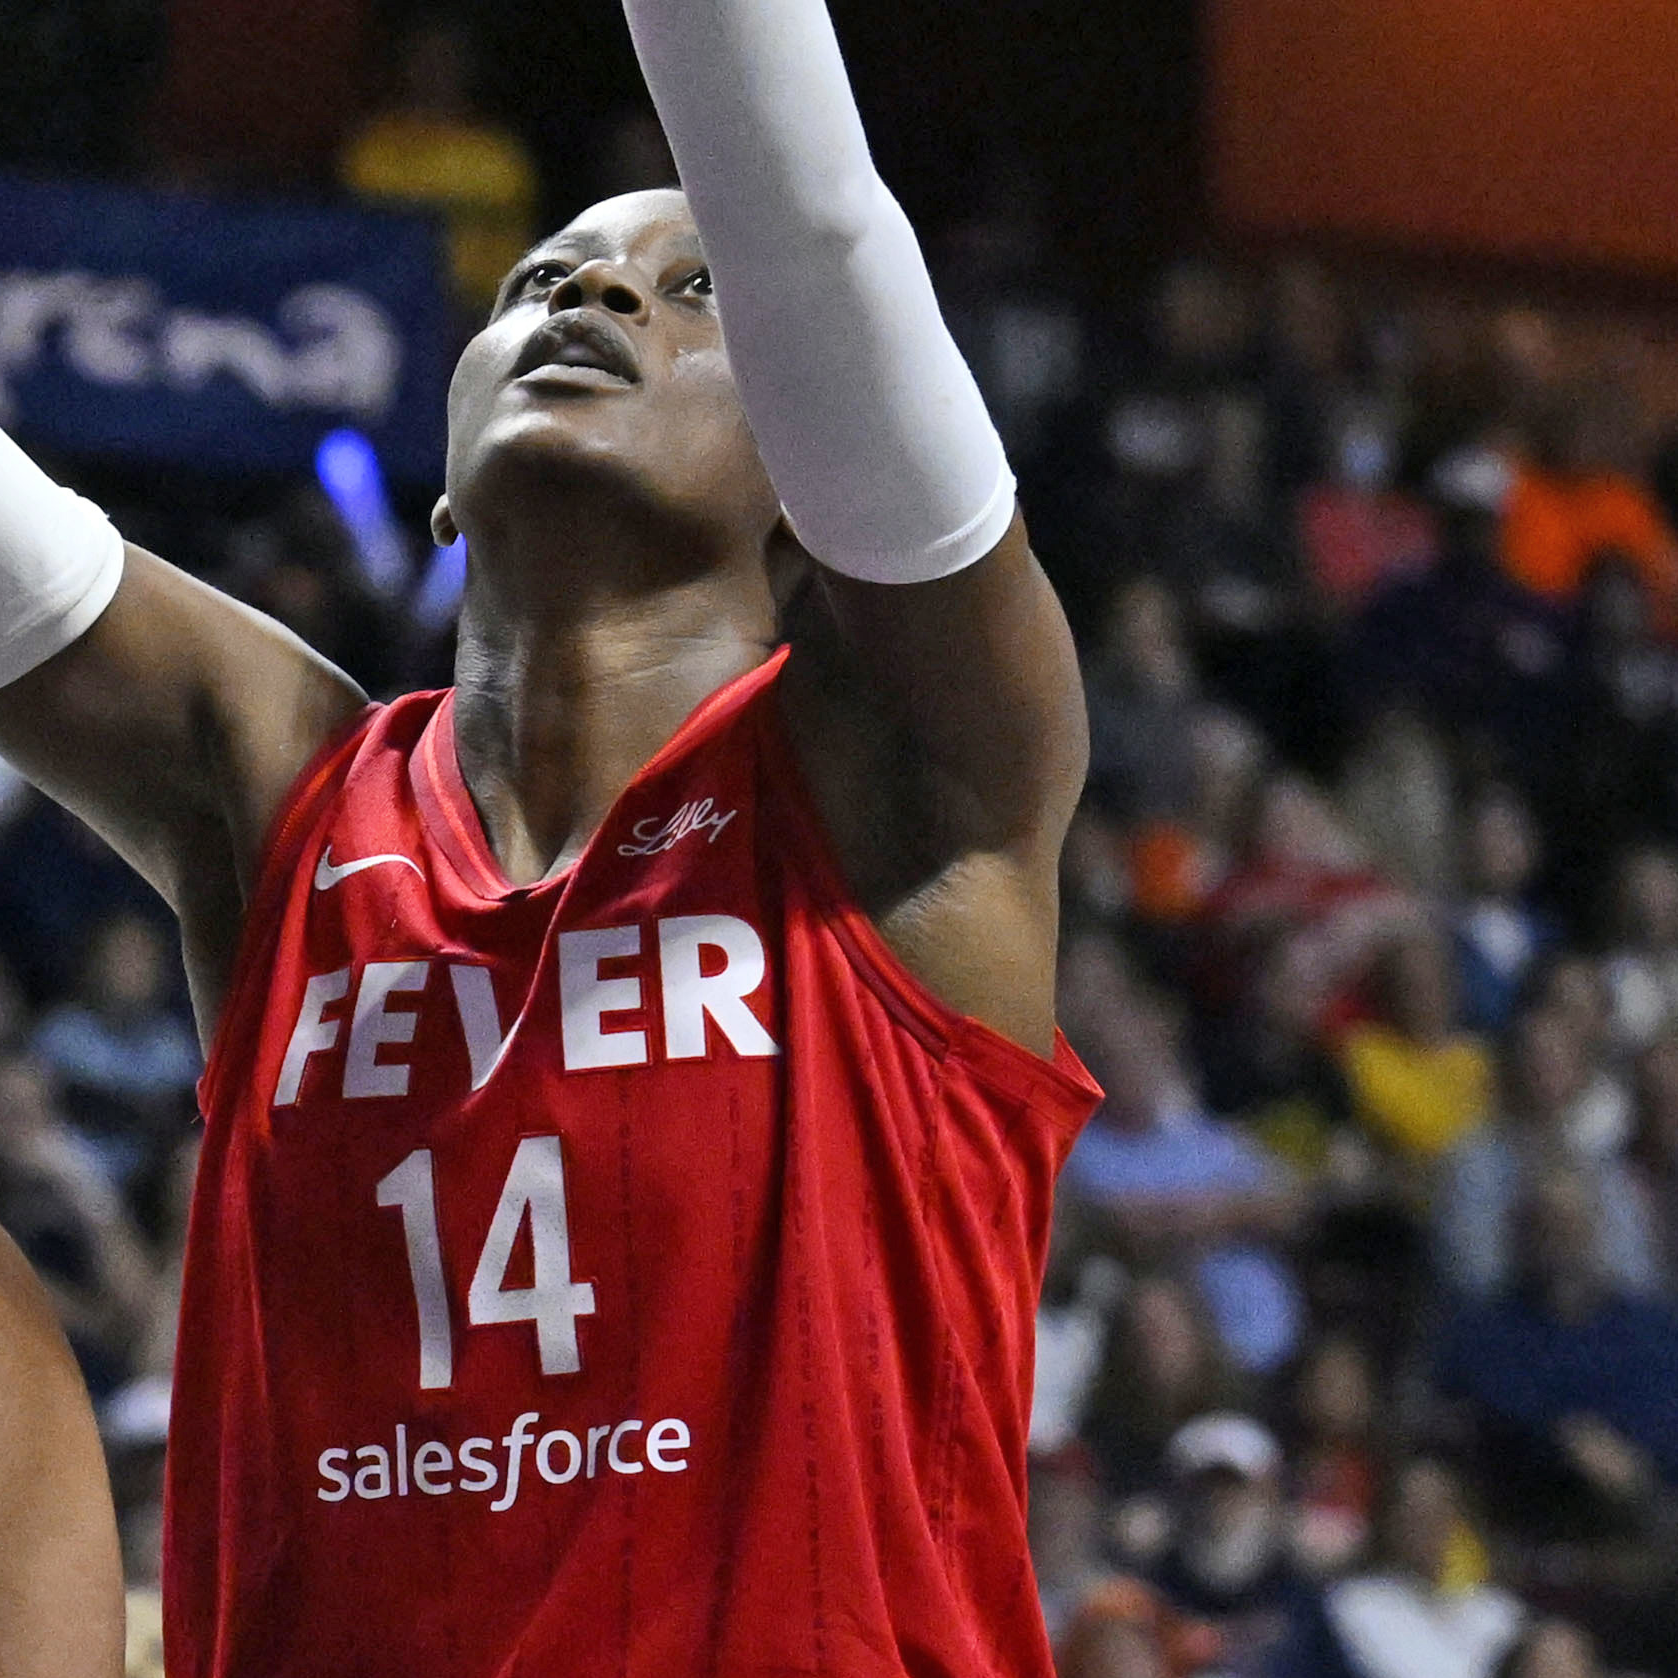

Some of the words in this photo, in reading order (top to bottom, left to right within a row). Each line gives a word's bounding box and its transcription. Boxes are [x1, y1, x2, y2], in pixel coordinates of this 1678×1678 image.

[617, 797, 737, 857] Lilly
[273, 913, 783, 1107] FEVER
[376, 1134, 596, 1391] 14
[317, 1412, 691, 1512] salesforce
